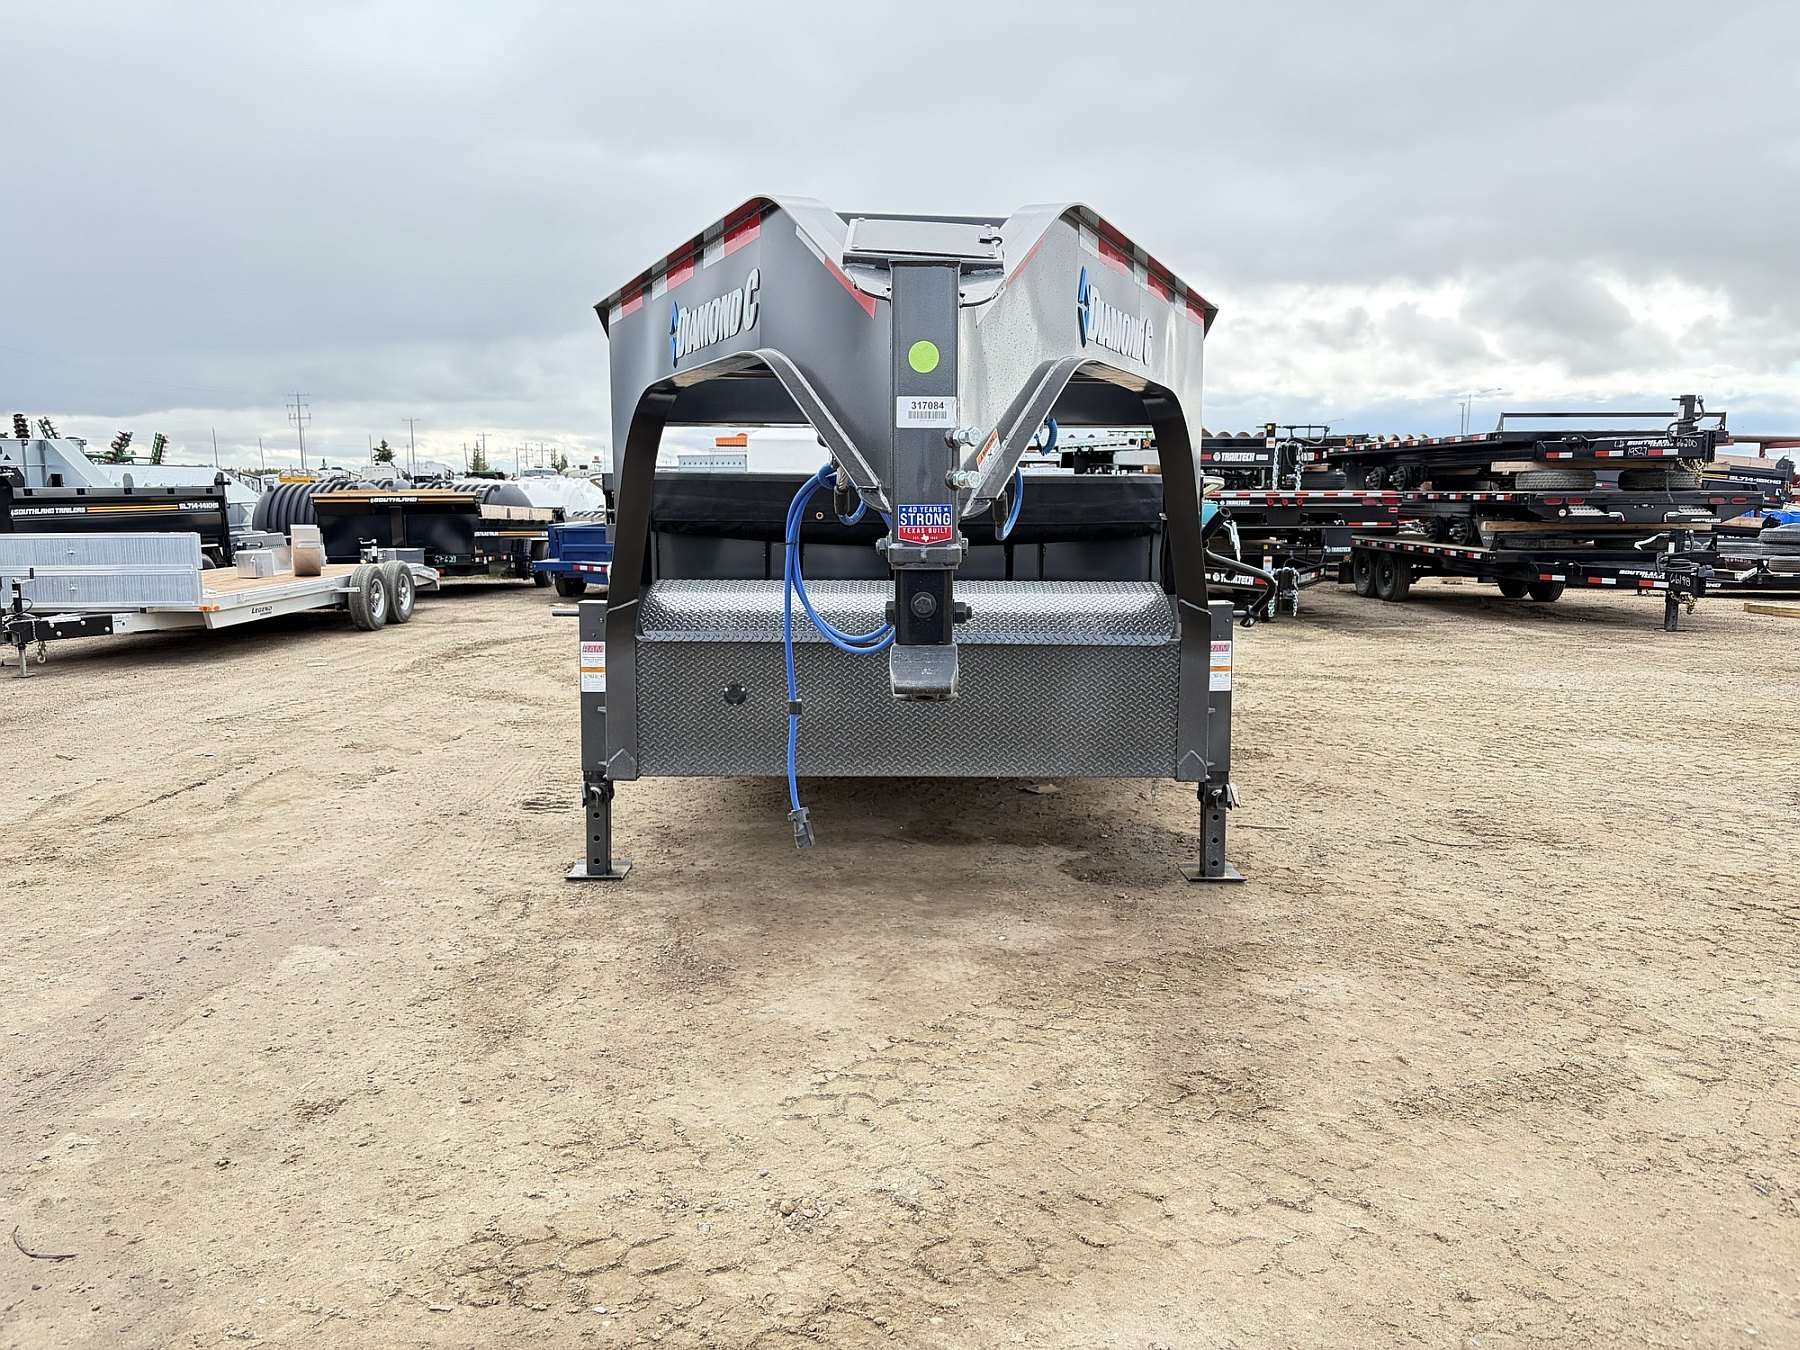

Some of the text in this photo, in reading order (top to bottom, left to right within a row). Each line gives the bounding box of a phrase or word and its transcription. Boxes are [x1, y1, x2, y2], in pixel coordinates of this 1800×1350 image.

[675, 267, 760, 360] DIAMOND C
[1086, 284, 1143, 362] DIAMOND
[911, 401, 944, 410] 317084
[1221, 452, 1256, 462] TRAILTECH
[900, 512, 951, 526] STRONG
